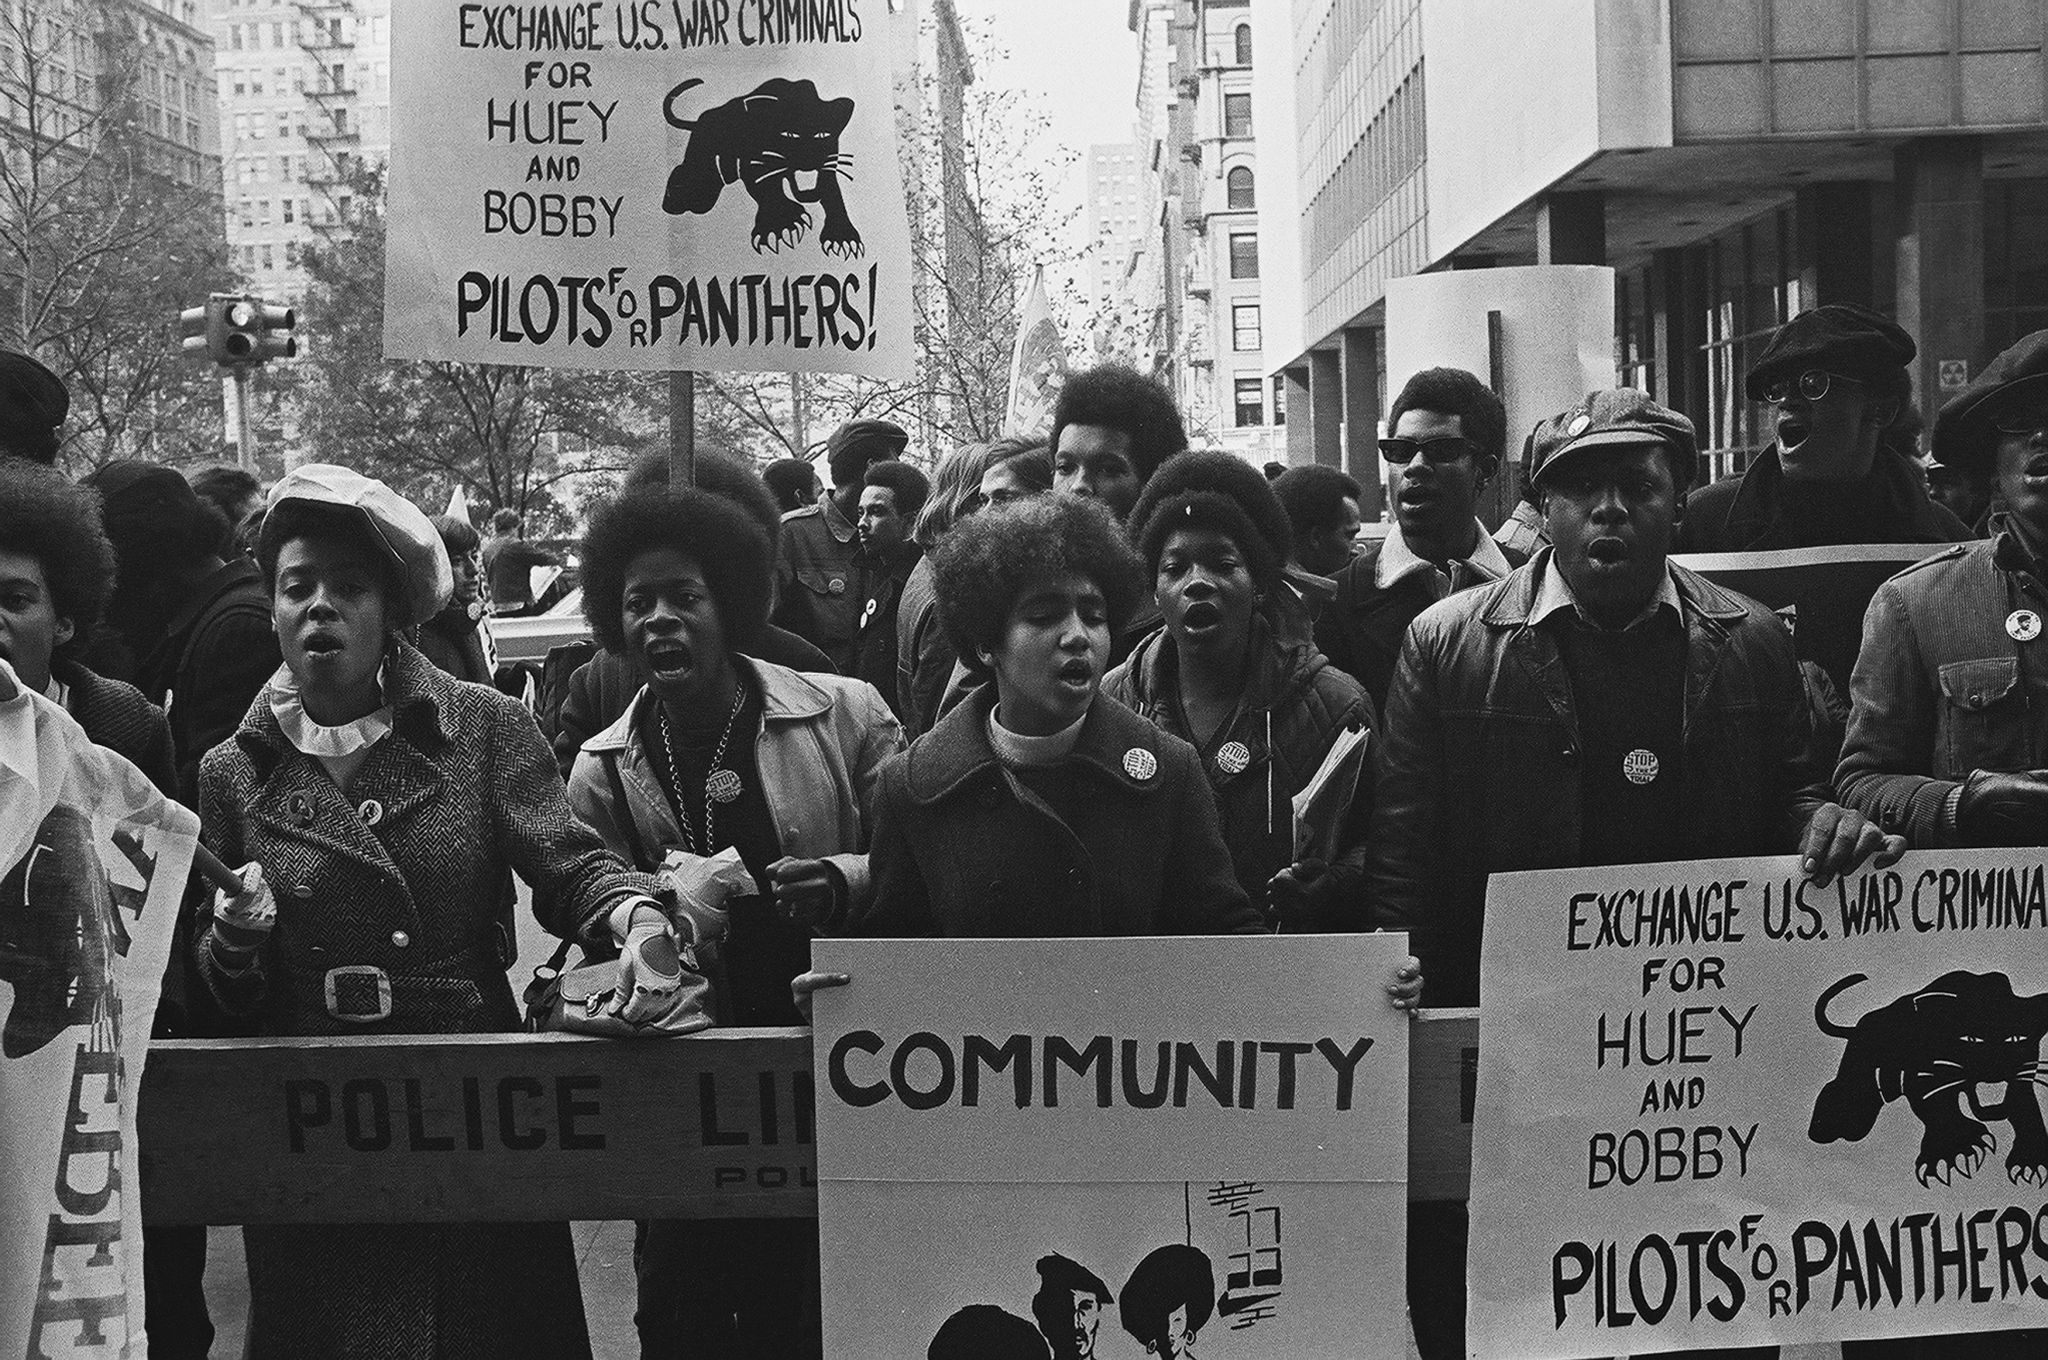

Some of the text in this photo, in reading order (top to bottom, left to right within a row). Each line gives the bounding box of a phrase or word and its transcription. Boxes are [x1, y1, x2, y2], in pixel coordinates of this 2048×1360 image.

[460, 0, 862, 51] EXCHANGE U.S. WAR CRIMINALS
[524, 61, 592, 90] FOR
[487, 99, 619, 145] HUEY
[525, 155, 580, 182] AND
[484, 190, 624, 238] BOBBY
[458, 263, 878, 351] PILOTS FOR PANTHERS!
[1223, 742, 1249, 762] STOP
[1627, 754, 1655, 765] STOP
[1567, 863, 2048, 950] EXCHANGE U.S. WAR CRIMINA
[1642, 956, 1726, 998] FOR
[1597, 1003, 1759, 1070] HUEY
[828, 1030, 1375, 1111] COMMUNITY
[284, 1074, 606, 1154] POLICE
[1638, 1076, 1705, 1117] AND
[1588, 1123, 1759, 1190] BOBBY
[1552, 1229, 1746, 1330] PILOTS
[1739, 1214, 1792, 1320] FOR
